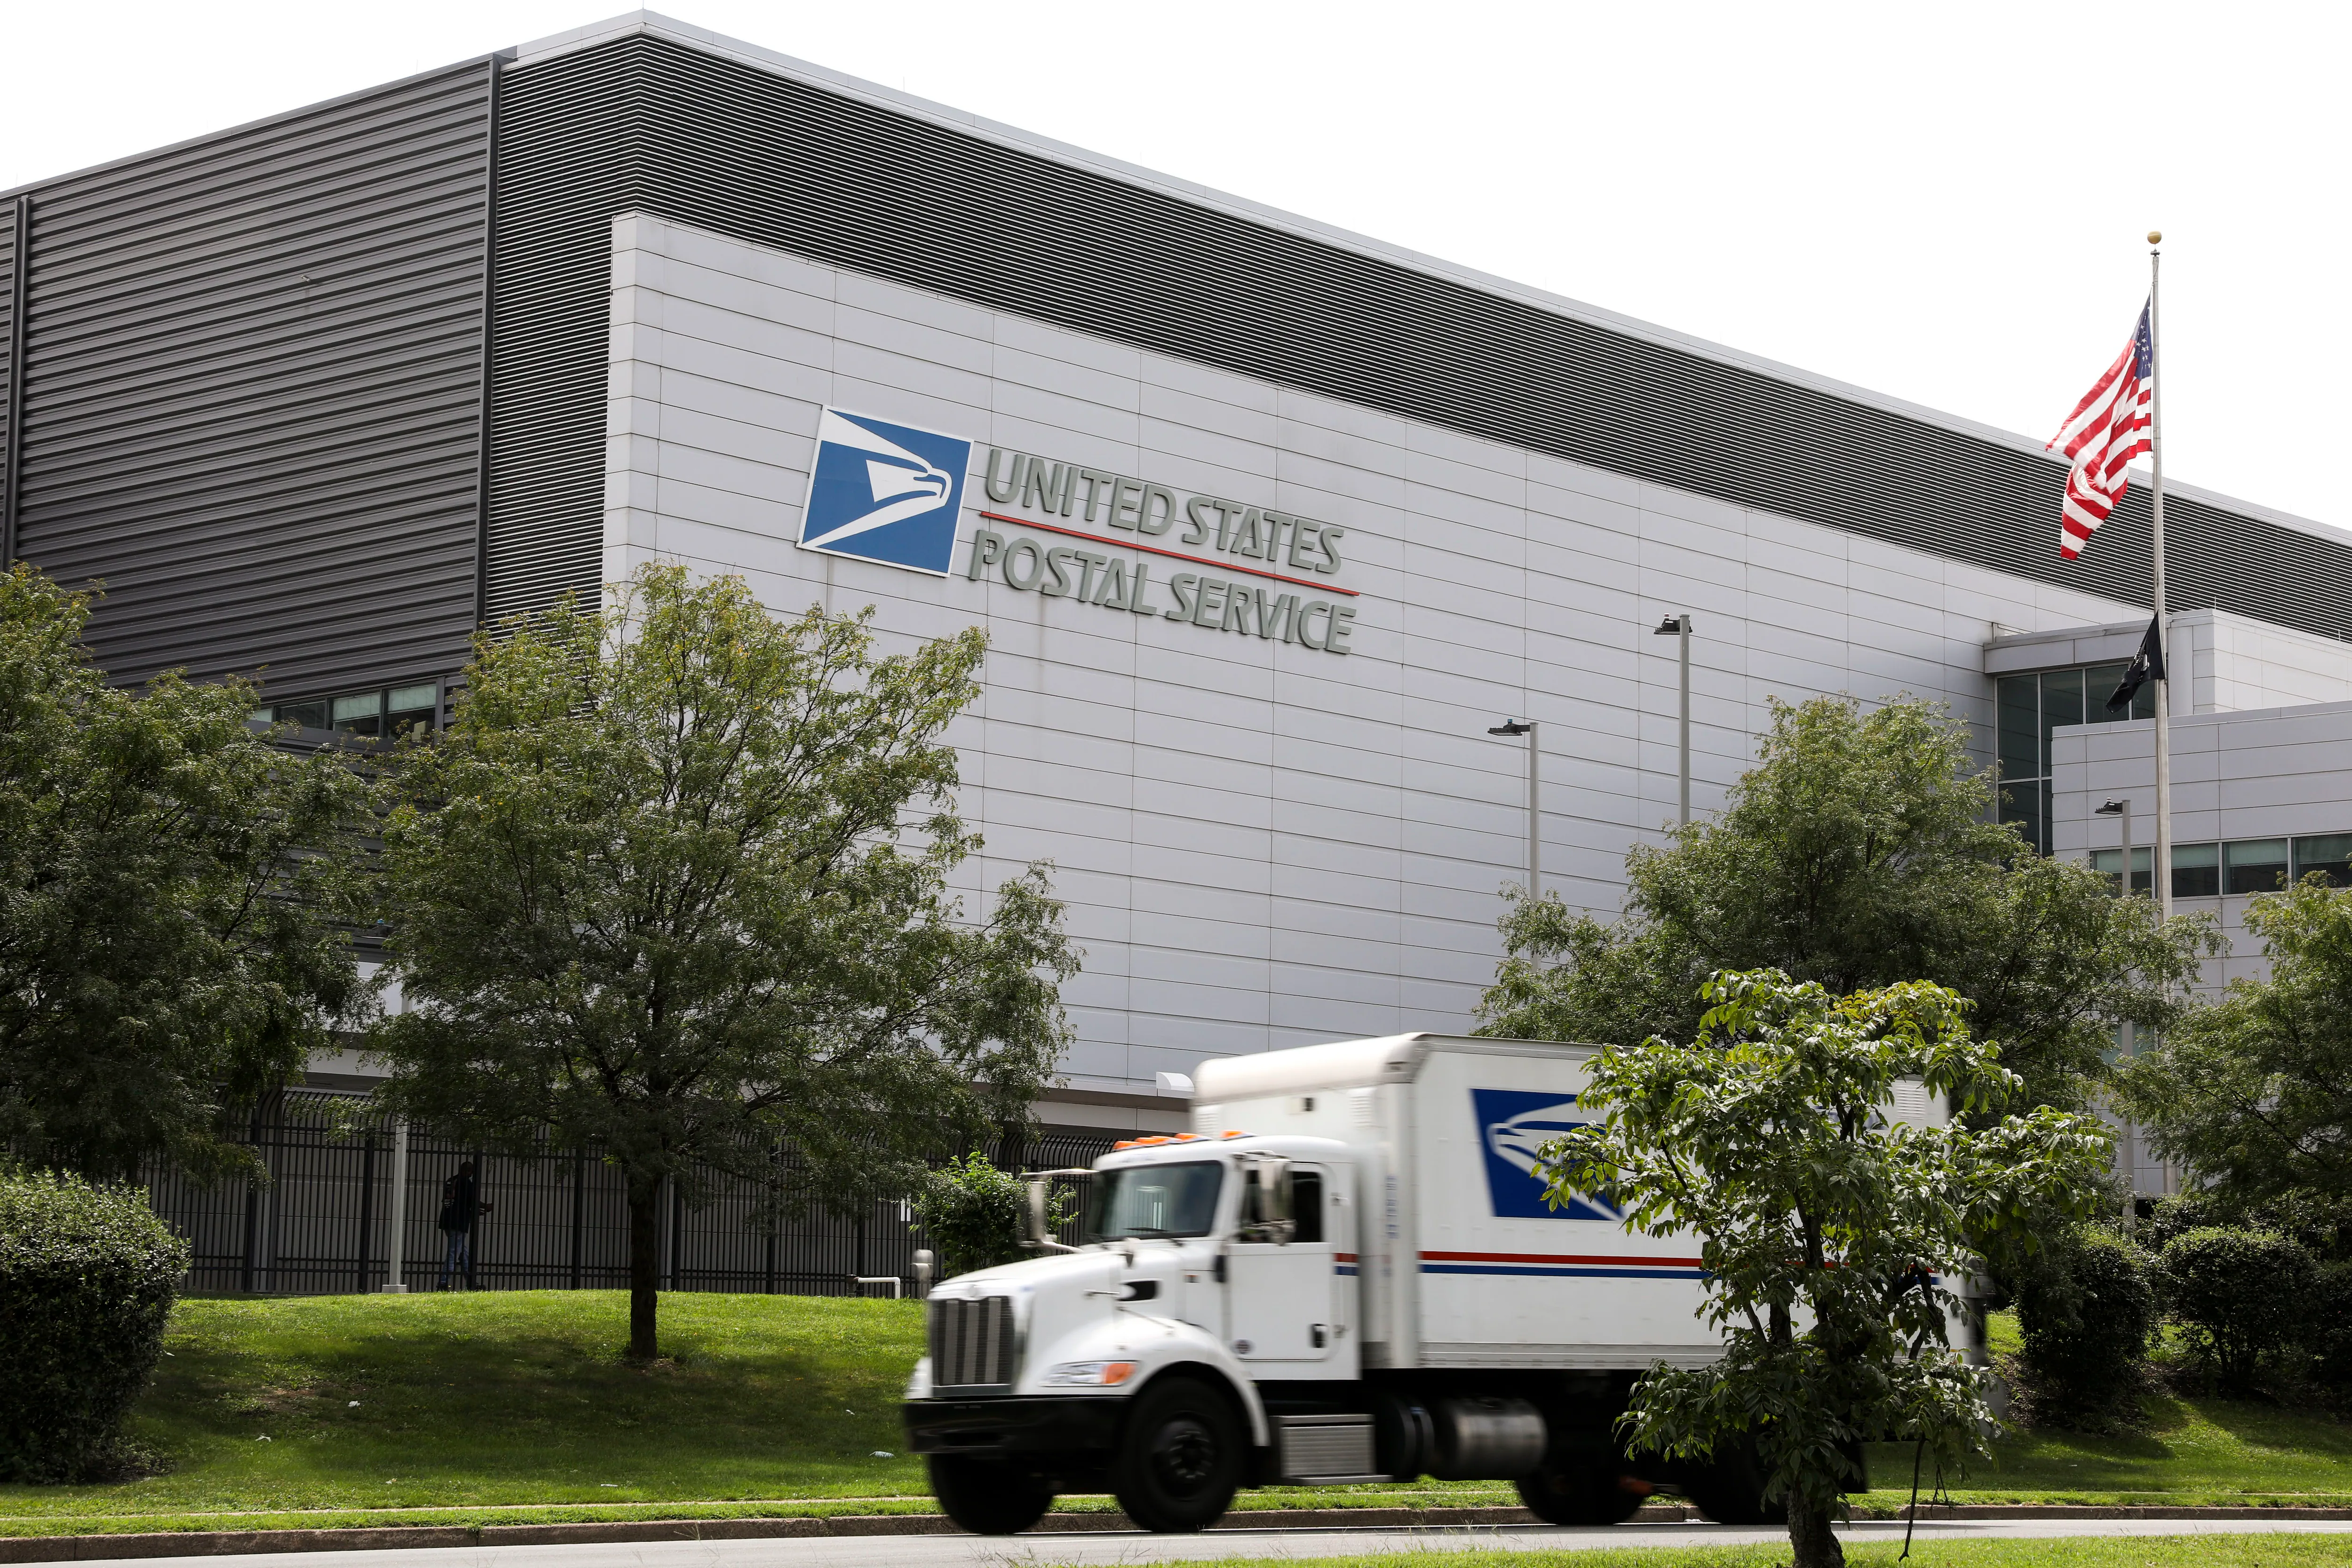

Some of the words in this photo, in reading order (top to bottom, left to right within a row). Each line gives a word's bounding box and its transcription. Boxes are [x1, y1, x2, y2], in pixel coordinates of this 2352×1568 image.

[986, 448, 1176, 535] UNITED
[1182, 496, 1344, 573] STATES
[969, 530, 1157, 615] POSTAL
[1166, 573, 1357, 654] SERVICE
